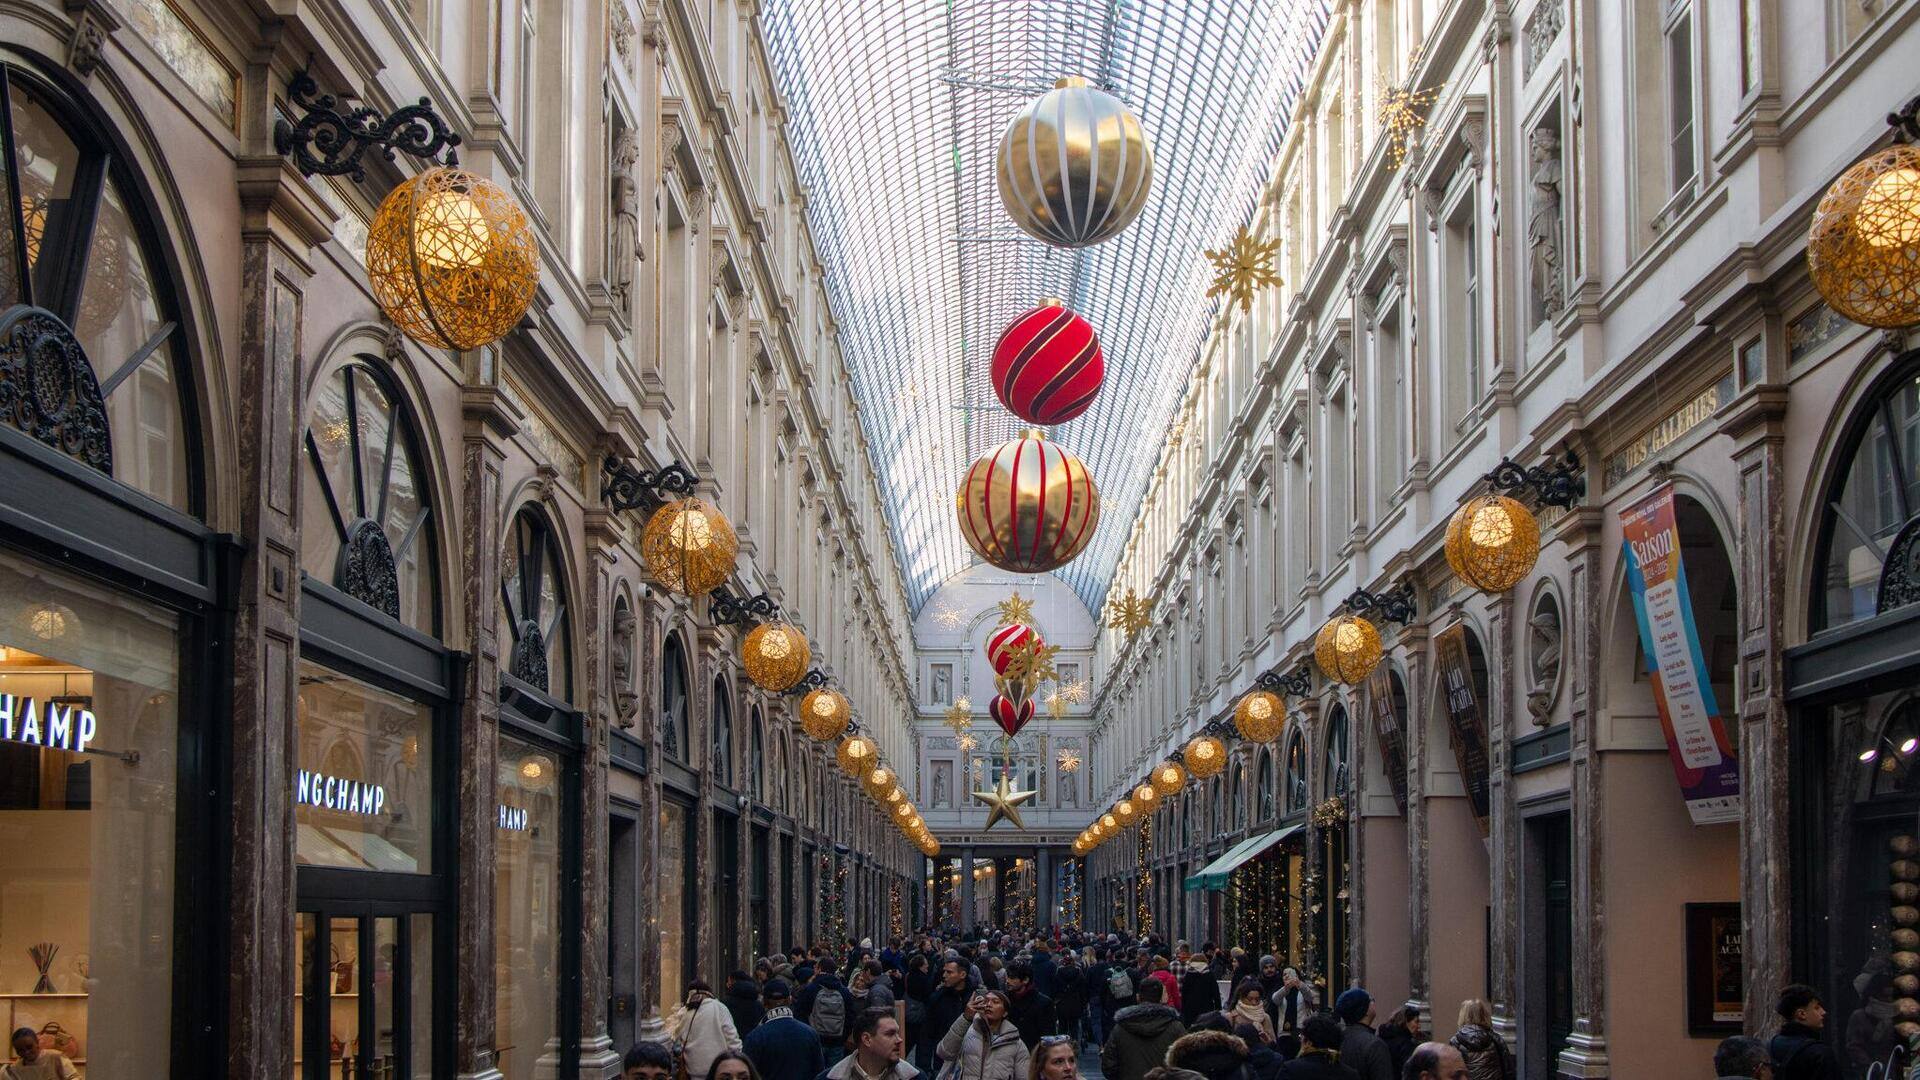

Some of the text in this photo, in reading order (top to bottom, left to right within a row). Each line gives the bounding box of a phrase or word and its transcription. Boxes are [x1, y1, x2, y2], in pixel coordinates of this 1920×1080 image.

[1626, 385, 1717, 473] DES GALERIES
[1631, 528, 1675, 569] Saison
[297, 768, 384, 815] NGCHAMP
[499, 804, 528, 831] HAMP
